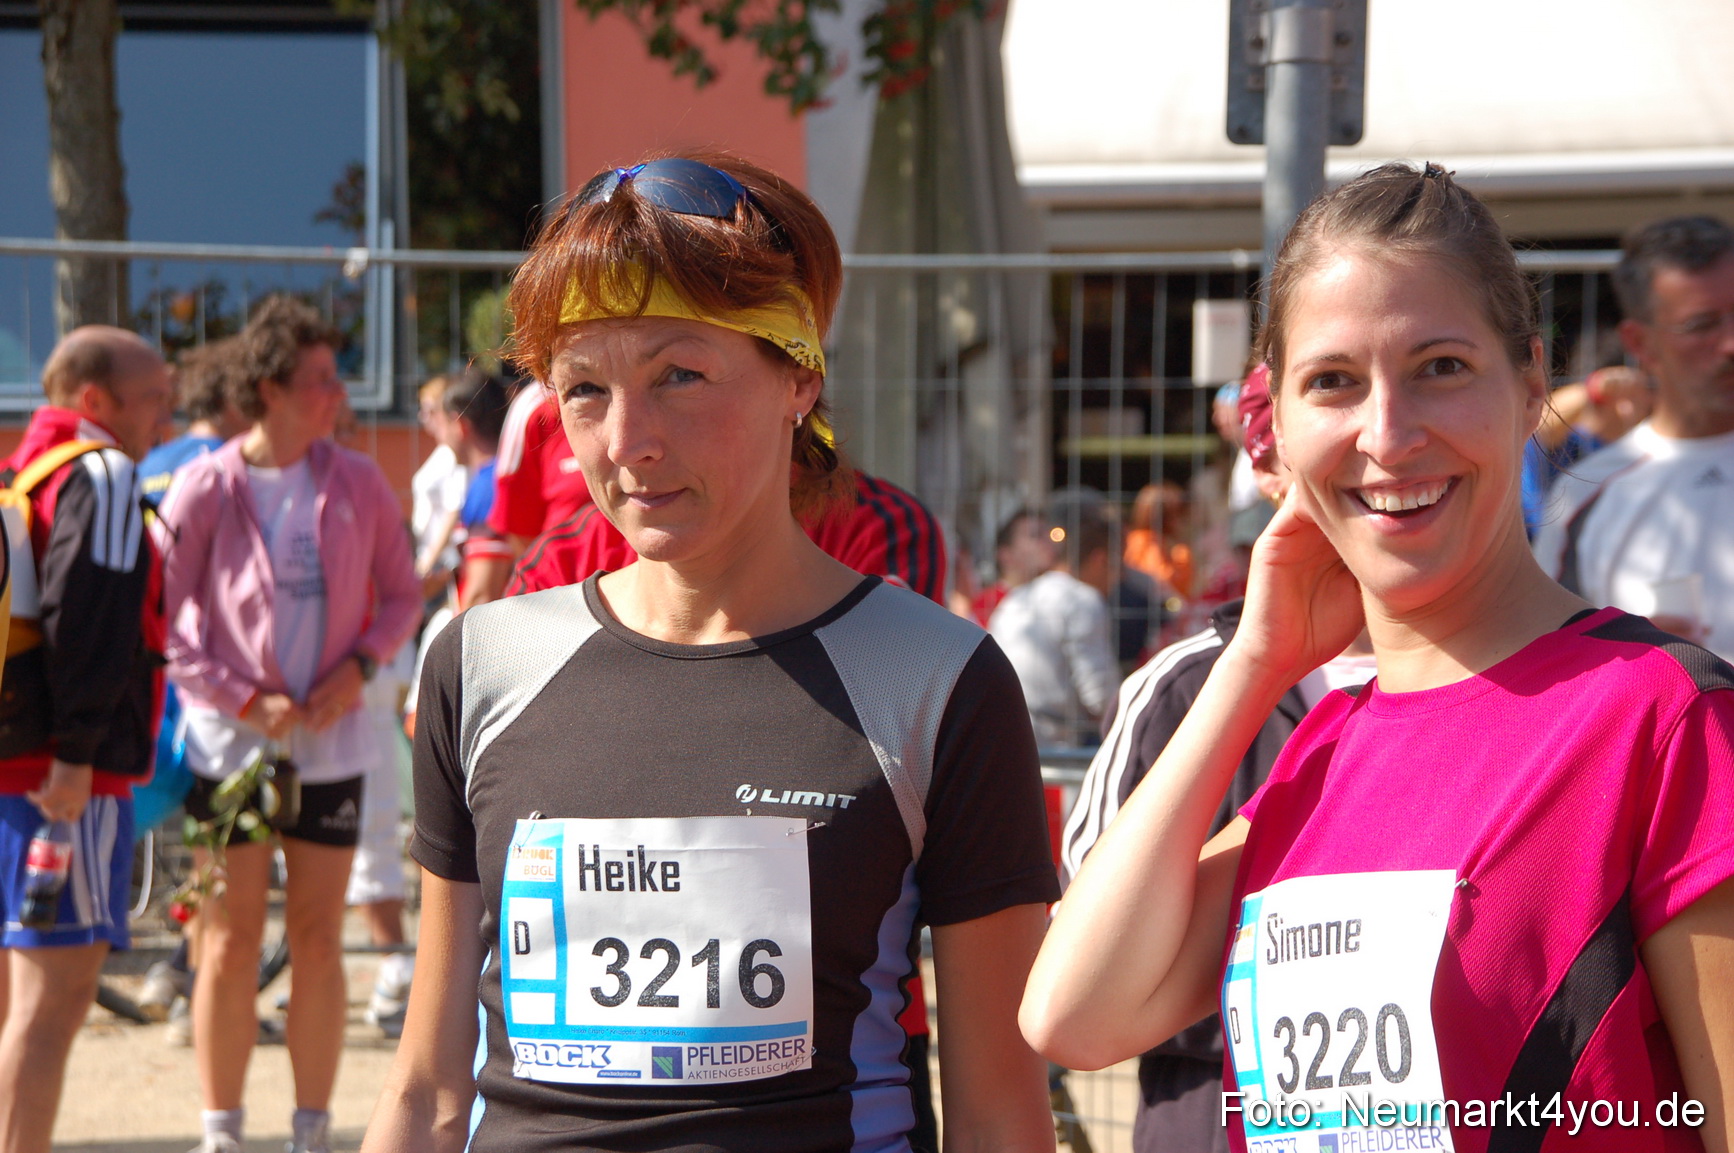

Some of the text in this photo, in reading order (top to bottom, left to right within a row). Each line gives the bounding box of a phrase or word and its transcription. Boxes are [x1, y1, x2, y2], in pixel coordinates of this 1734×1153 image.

[760, 789, 857, 808] LIMIT
[524, 864, 554, 876] BÜGL
[578, 844, 681, 892] Heike
[513, 920, 531, 955] D
[1266, 912, 1362, 965] Simone
[589, 937, 786, 1009] 3216
[1229, 1007, 1241, 1044] D
[514, 1042, 611, 1068] BOCK
[687, 1038, 806, 1066] PFLEIDERER
[1273, 1003, 1412, 1095] 3220
[687, 1056, 806, 1080] AKTIENGESELLSCHAFT
[1341, 1126, 1445, 1153] PFLEIDERER
